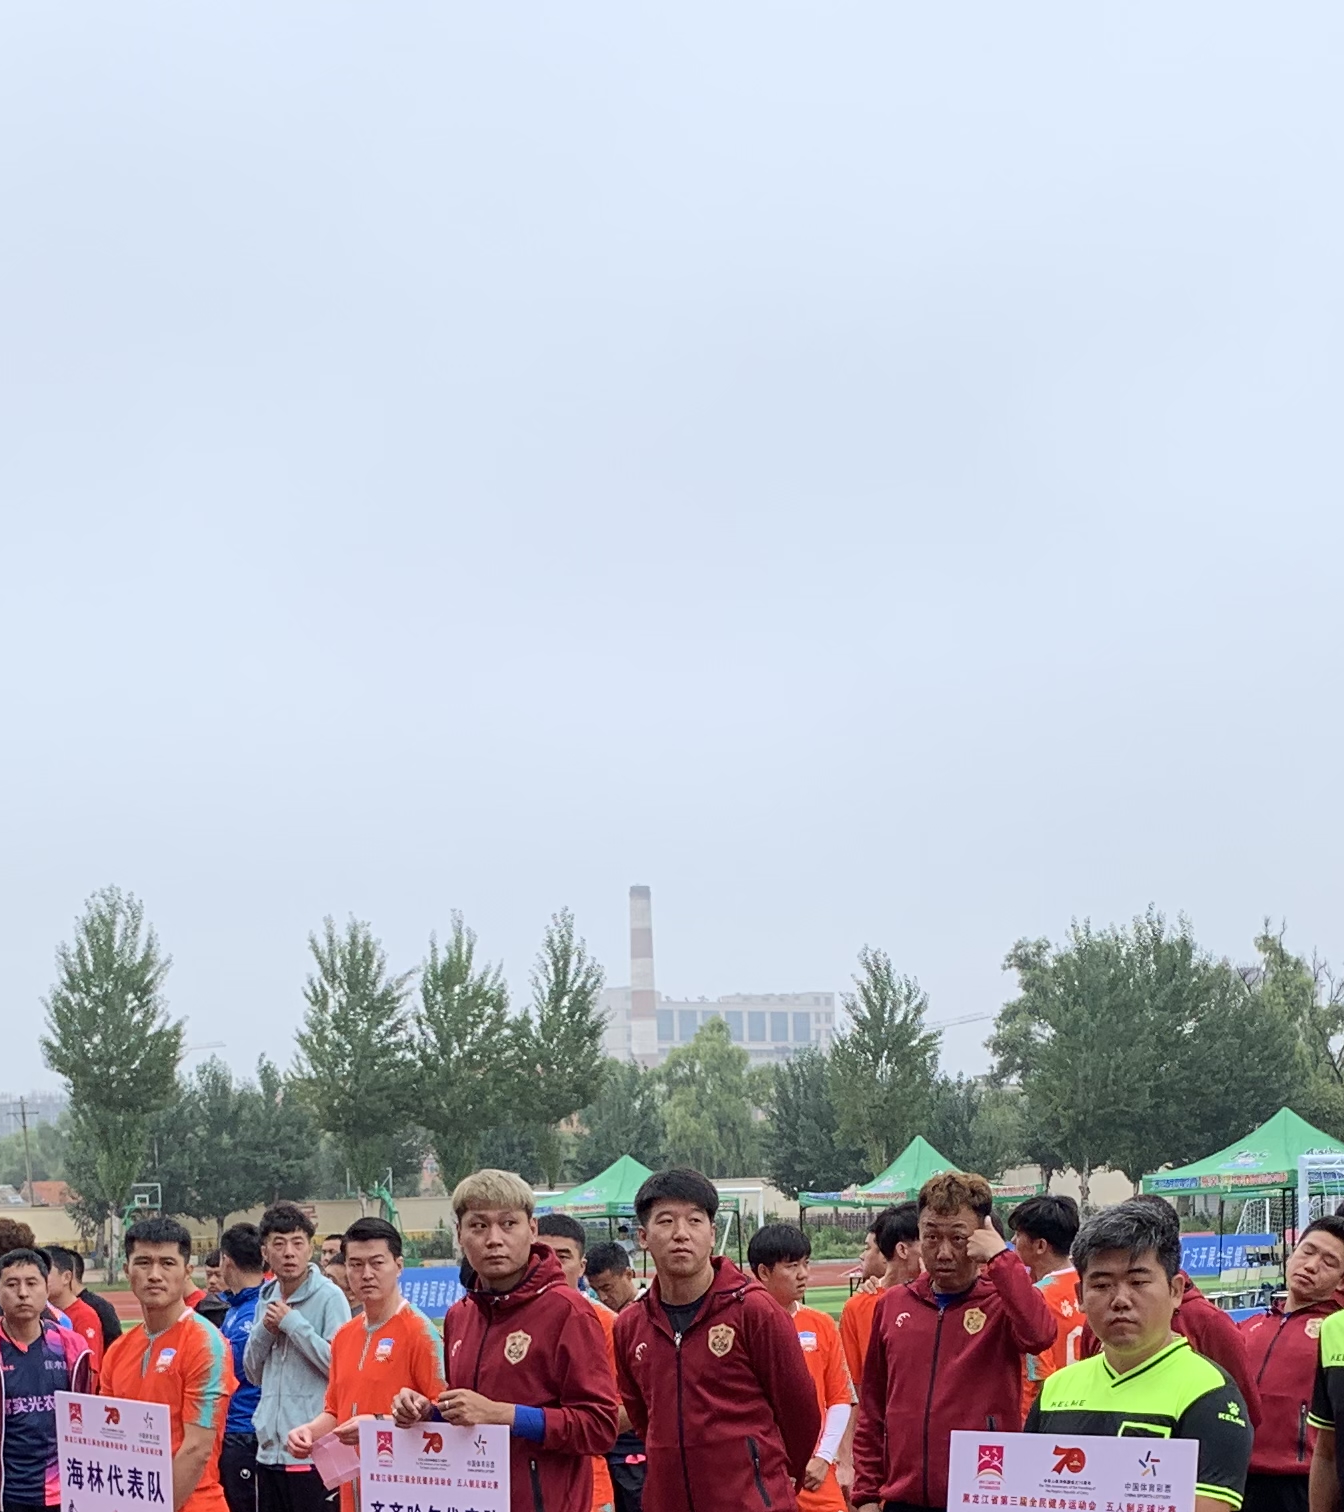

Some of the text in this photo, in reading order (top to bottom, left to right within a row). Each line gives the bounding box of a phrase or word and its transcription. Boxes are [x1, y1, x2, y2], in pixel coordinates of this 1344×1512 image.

[1051, 1445, 1086, 1475] 70
[66, 1458, 165, 1504] 海林代表队
[962, 1493, 1097, 1511] 黑龙江省第三届全民健身运动会
